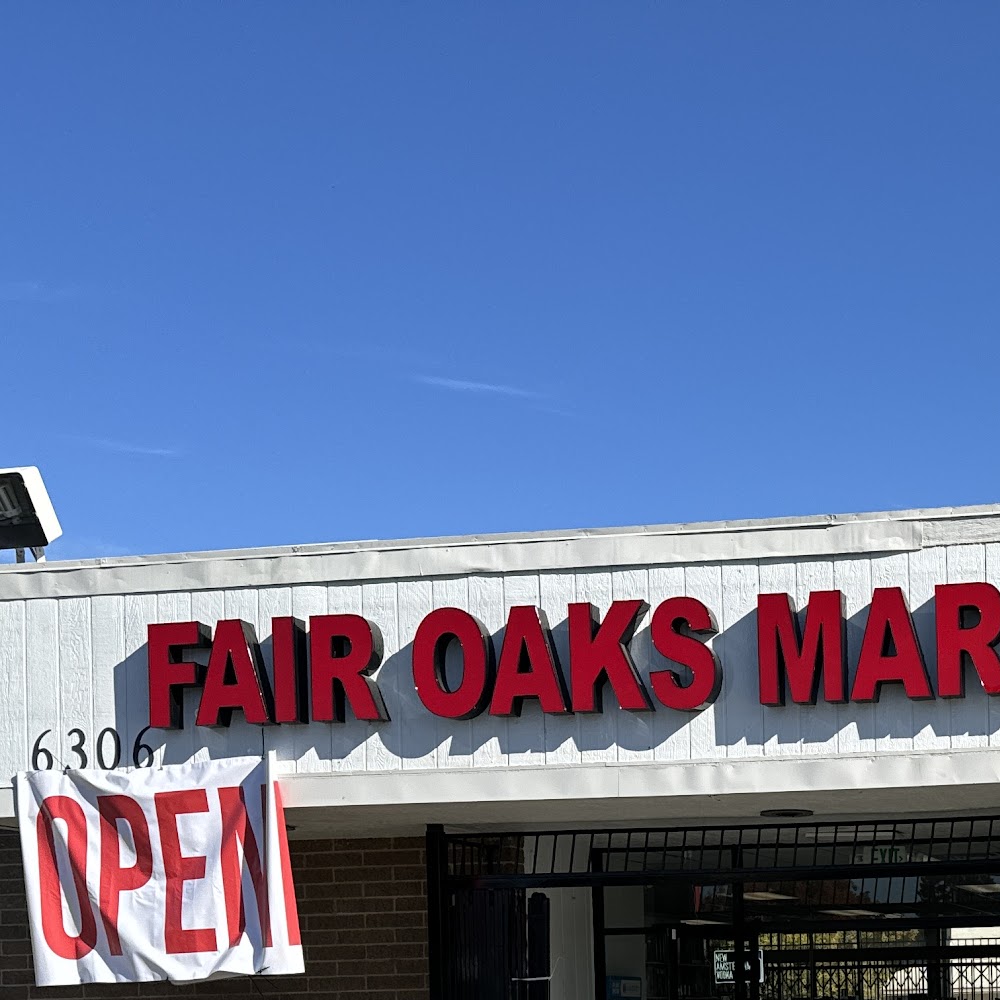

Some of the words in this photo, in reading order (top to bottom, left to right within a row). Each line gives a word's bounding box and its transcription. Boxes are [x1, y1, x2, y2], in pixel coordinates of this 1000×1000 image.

[148, 614, 390, 729] FAIR
[413, 597, 722, 720] OAKS
[31, 726, 153, 770] 6306
[37, 781, 273, 960] OPEN
[871, 848, 900, 864] EXIT
[716, 953, 728, 962] NEW
[717, 970, 734, 980] VODKA
